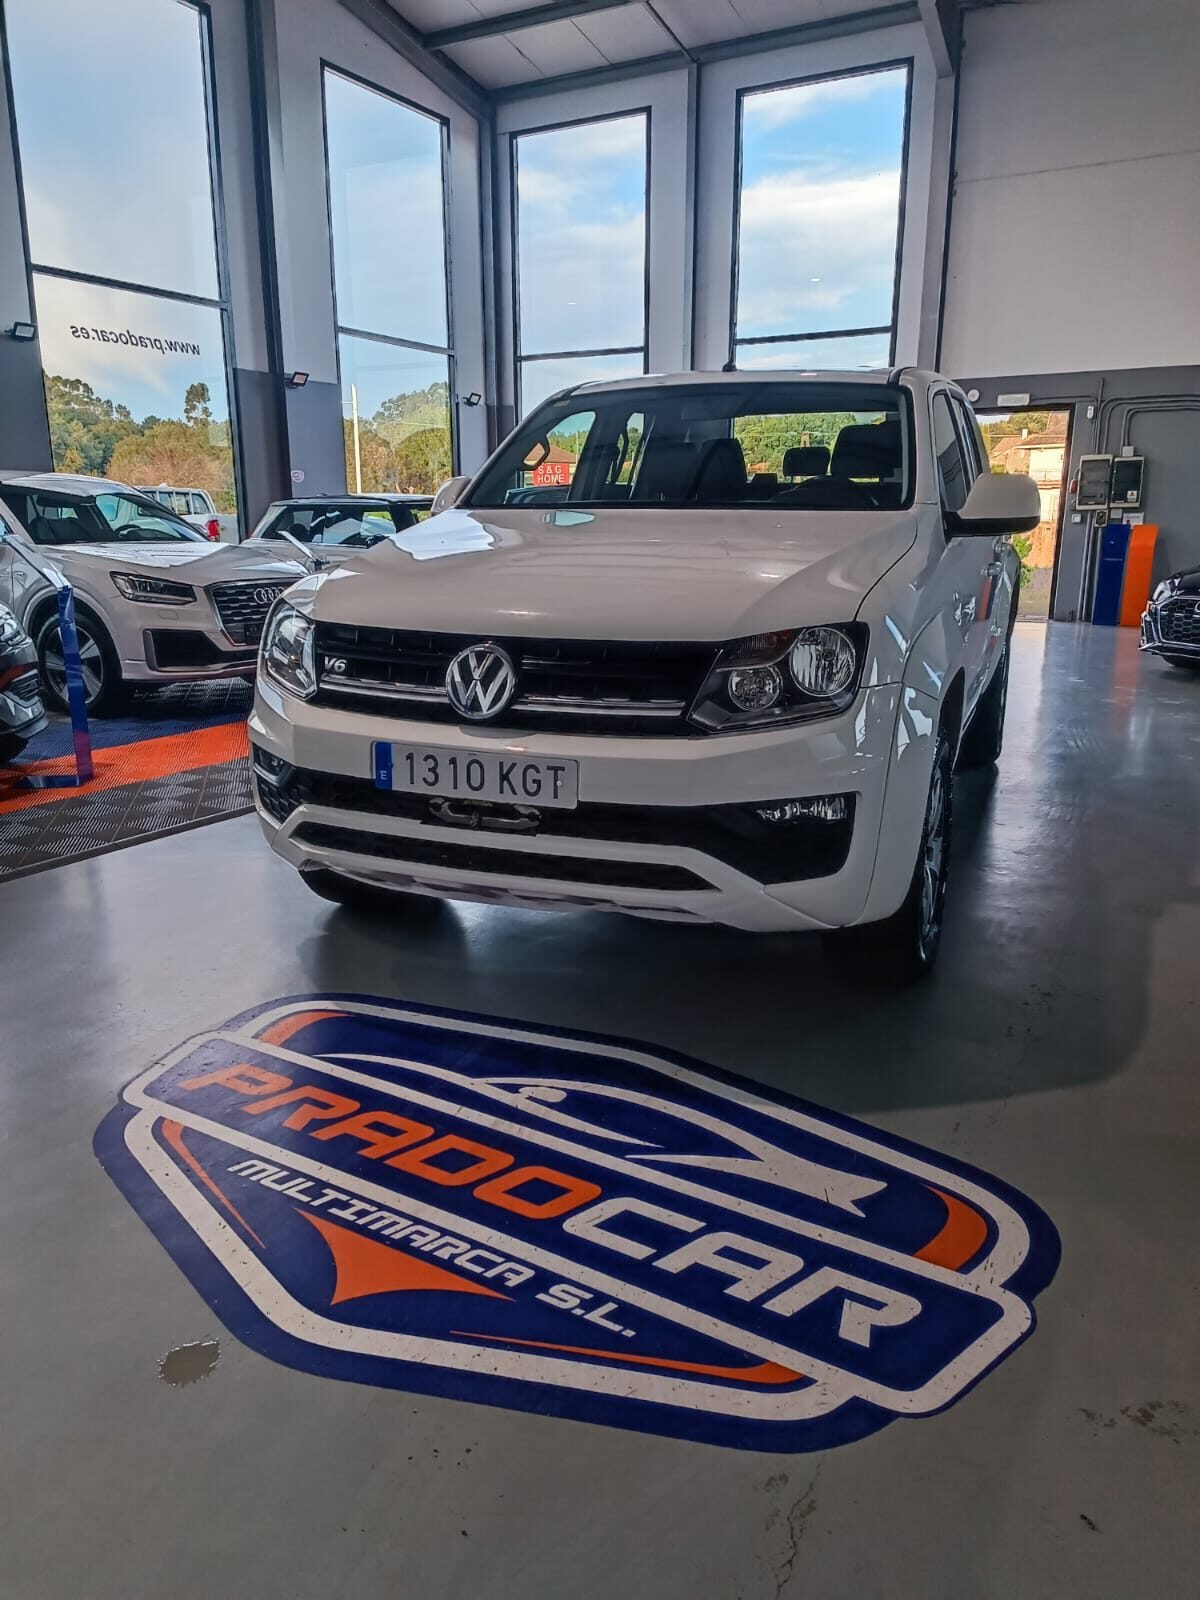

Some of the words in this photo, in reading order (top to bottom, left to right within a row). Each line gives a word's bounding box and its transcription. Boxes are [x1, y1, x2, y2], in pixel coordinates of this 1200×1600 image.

[538, 465, 544, 474] S
[546, 465, 553, 474] &
[555, 465, 562, 474] G
[537, 474, 565, 483] HOME
[324, 656, 347, 672] V6
[379, 770, 388, 780] E
[405, 752, 485, 792] 1310
[499, 761, 566, 800] KGT
[226, 1158, 536, 1288] MULTIMARCA
[535, 1282, 637, 1338] S.L.
